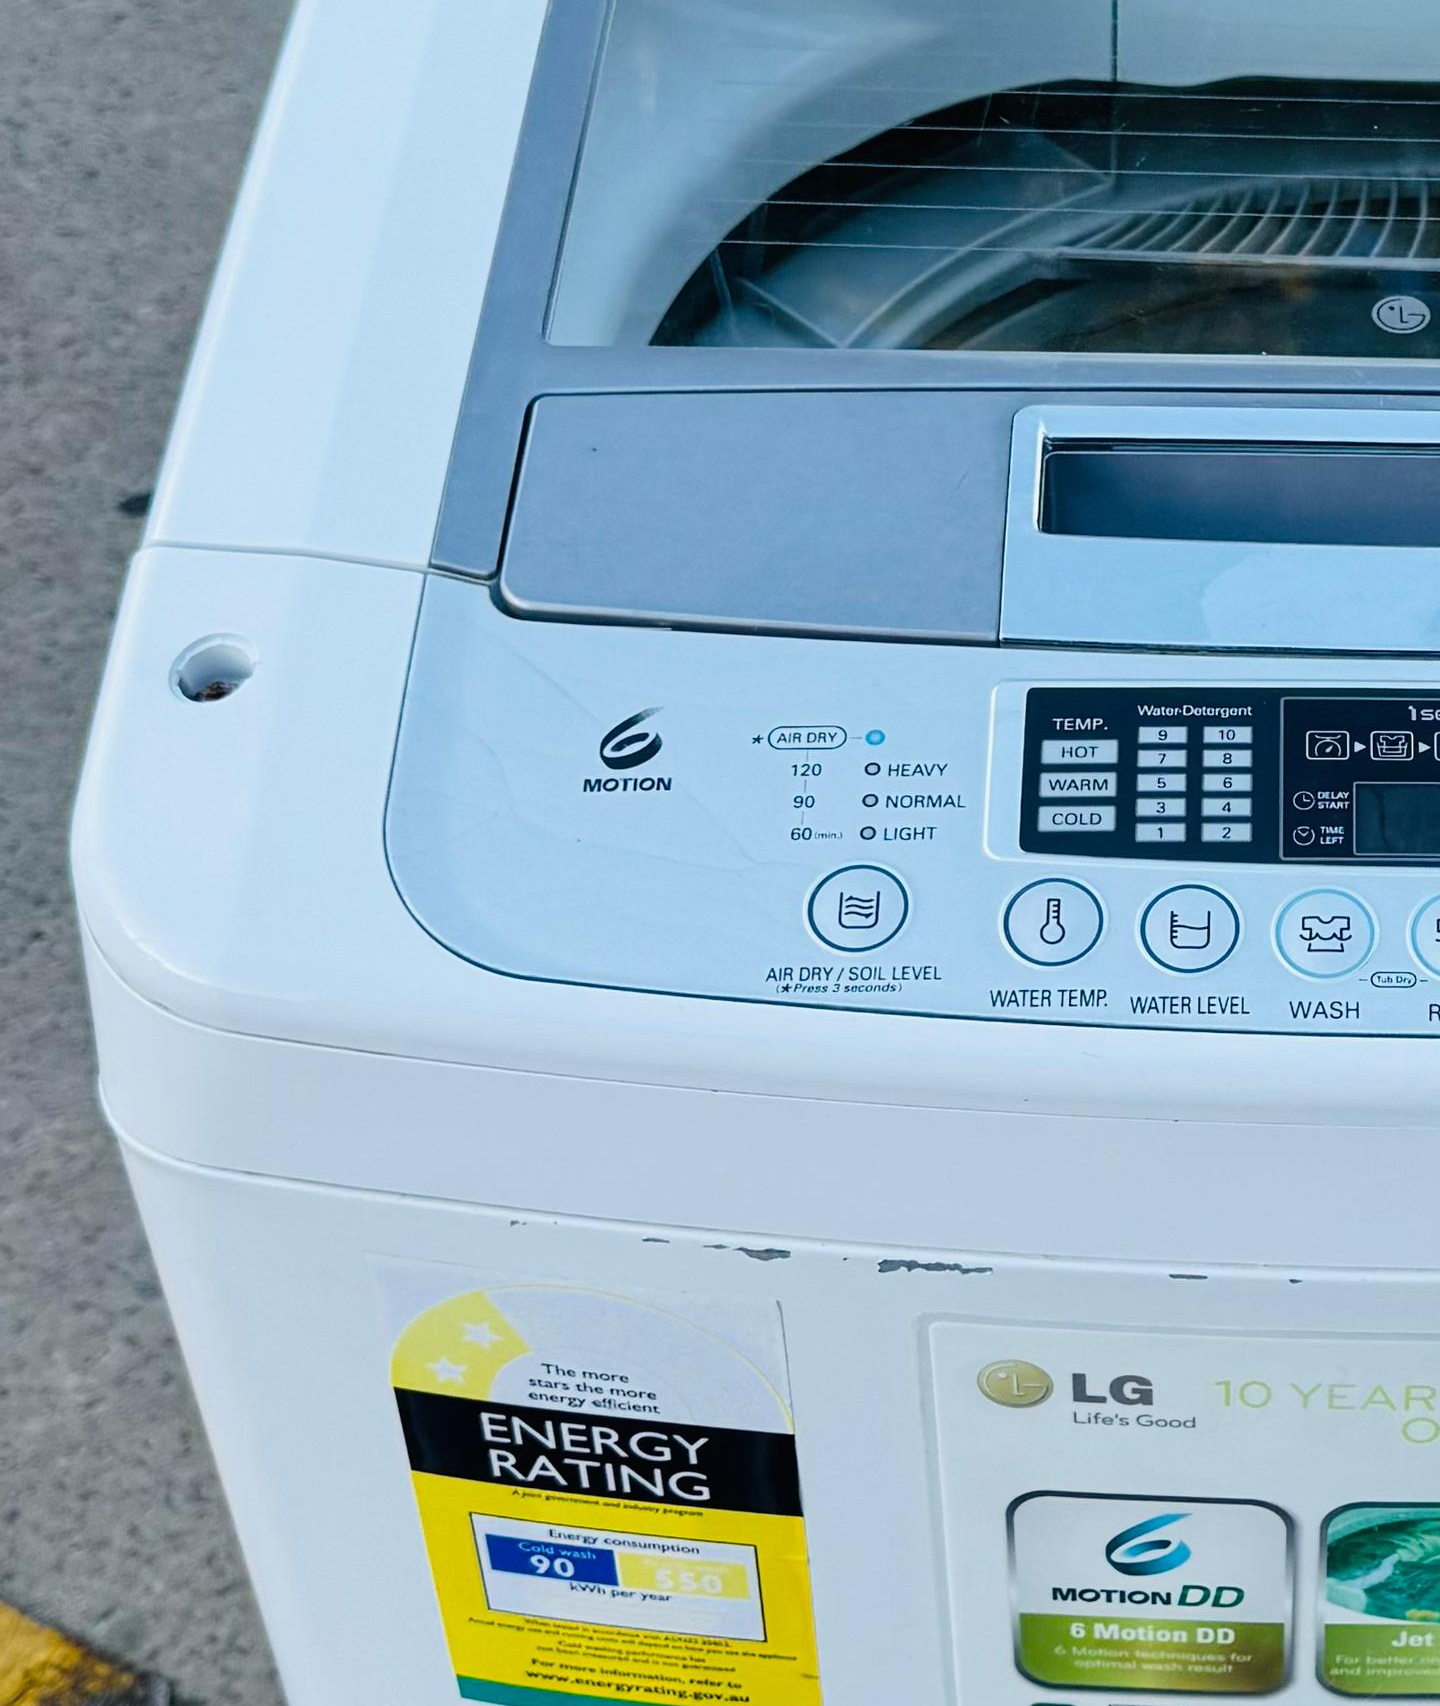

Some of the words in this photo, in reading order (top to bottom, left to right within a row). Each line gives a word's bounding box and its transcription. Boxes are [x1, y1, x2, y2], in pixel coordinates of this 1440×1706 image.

[1052, 718, 1108, 731] TEMP.
[776, 731, 801, 745] AIR
[806, 730, 838, 744] DRY
[1158, 729, 1168, 741] 9
[1218, 729, 1236, 741] 10
[1061, 746, 1099, 758] HOT
[1158, 753, 1167, 765] 7
[1222, 752, 1232, 765] 8
[790, 763, 822, 777] 120
[887, 763, 948, 777] HEAVY
[582, 777, 673, 793] MOTION
[1048, 778, 1109, 791] WARM
[1157, 777, 1166, 789] 5
[1223, 777, 1232, 789] 6
[792, 795, 815, 809] 90
[885, 794, 966, 809] NORMAL
[1317, 791, 1350, 799] DELAY
[1156, 801, 1166, 814] 3
[1222, 801, 1232, 814] 4
[1317, 801, 1350, 810] START
[1052, 812, 1102, 825] COLD
[884, 826, 938, 841] LIGHT
[1156, 827, 1164, 839] 1
[1222, 827, 1232, 839] 2
[1320, 826, 1344, 834] TIME
[1320, 836, 1344, 845] LEFT
[765, 967, 793, 982] AIR
[799, 967, 834, 982] DRY
[848, 966, 886, 981] SOIL
[892, 966, 943, 981] LEVEL
[1377, 976, 1393, 984] Tub
[1396, 976, 1412, 985] Dry
[832, 983, 841, 994] 3
[990, 990, 1052, 1008] WATER
[1057, 989, 1109, 1008] TEMP.
[1130, 996, 1192, 1015] WATER
[1198, 996, 1250, 1015] LEVEL
[1289, 1000, 1361, 1020] WASH
[541, 1363, 576, 1377] The
[582, 1370, 629, 1383] more
[529, 1378, 570, 1390] stars
[576, 1382, 604, 1394] the
[610, 1387, 657, 1400] more
[1072, 1373, 1154, 1406] LG
[1215, 1380, 1272, 1408] 10
[1291, 1383, 1438, 1412] YEAR
[528, 1392, 586, 1408] energy
[592, 1398, 661, 1414] efficient
[1073, 1412, 1130, 1427] Life's
[1136, 1414, 1196, 1430] Good
[479, 1411, 709, 1464] ENERGY
[489, 1449, 710, 1501] RATING
[549, 1528, 598, 1544] Energy
[604, 1536, 700, 1554] consumption
[518, 1542, 554, 1555] Cold
[559, 1549, 596, 1560] wash
[530, 1554, 575, 1578] 90
[570, 1582, 606, 1595] kWh
[611, 1588, 635, 1599] per
[641, 1593, 672, 1602] year
[1051, 1587, 1172, 1605] MOTION
[1177, 1584, 1245, 1608] DD
[1070, 1622, 1085, 1638] 6
[1093, 1623, 1188, 1643] Motion
[1196, 1627, 1236, 1644] DD
[1391, 1631, 1434, 1647] Jet
[531, 1658, 555, 1667] For
[559, 1663, 596, 1673] more
